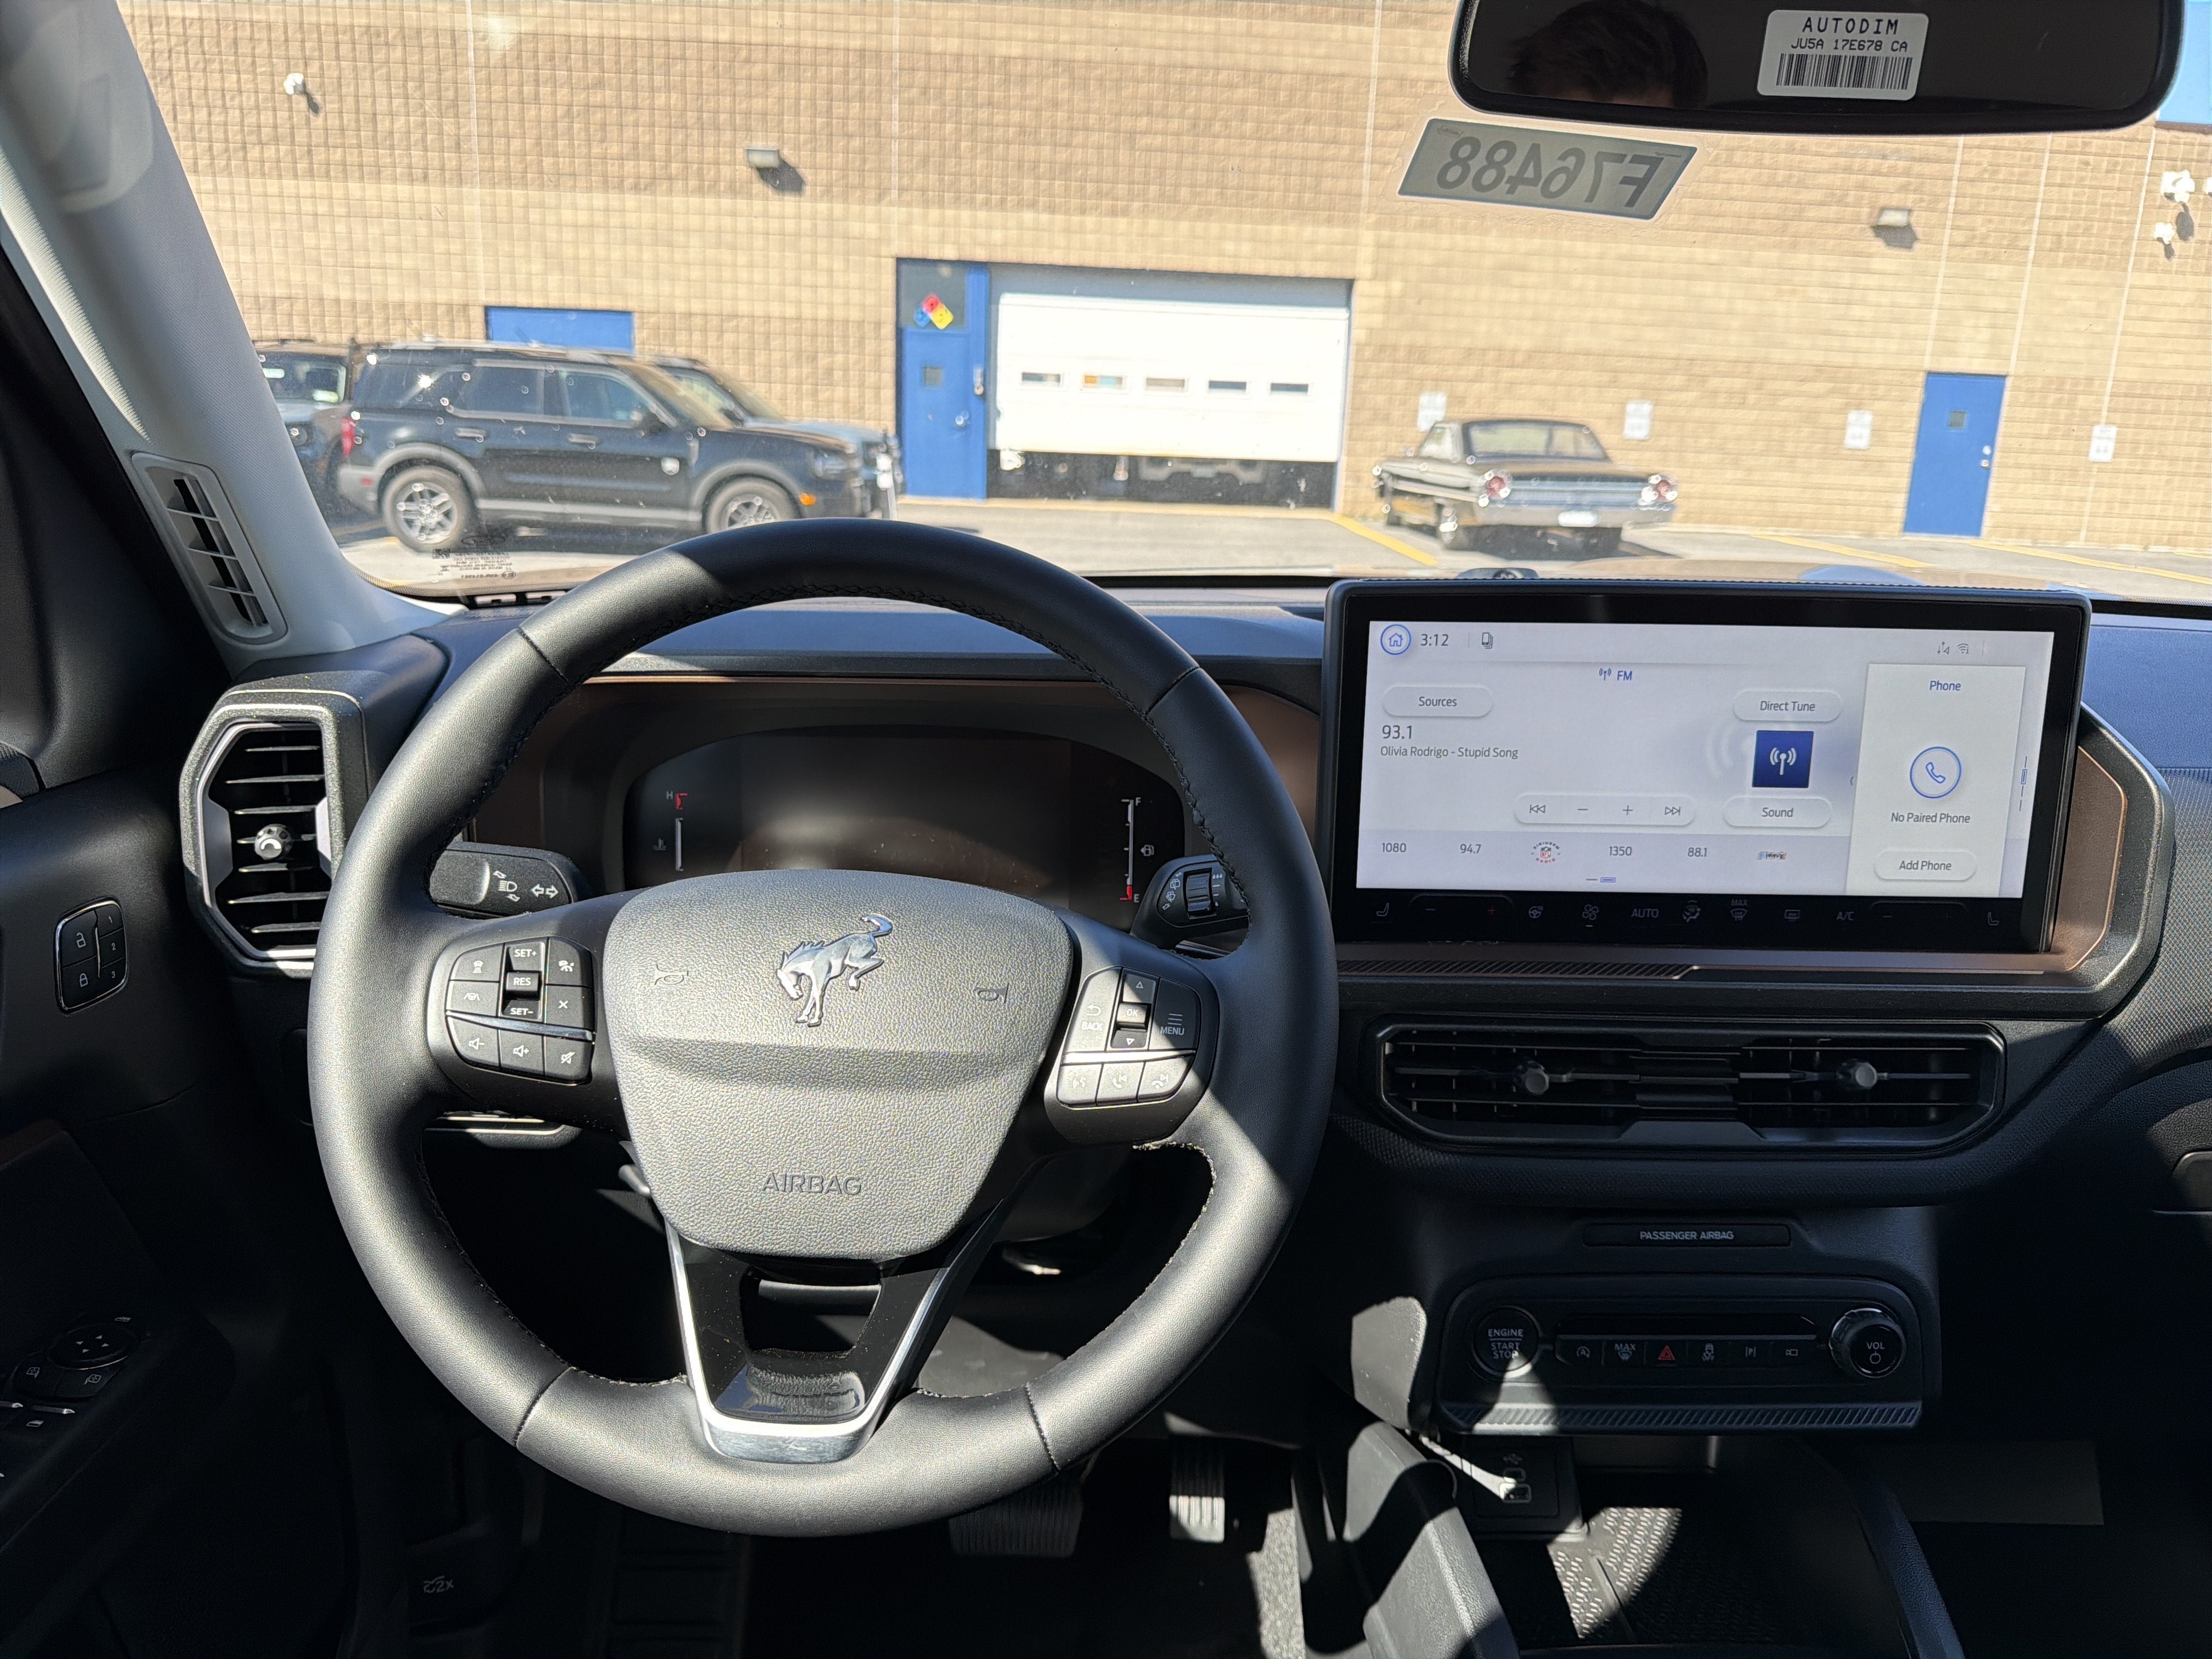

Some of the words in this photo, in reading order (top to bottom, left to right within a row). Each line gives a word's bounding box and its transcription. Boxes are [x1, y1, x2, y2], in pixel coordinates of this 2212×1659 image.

[1802, 17, 1899, 35] AUTODIM
[1791, 38, 1824, 49] JU5A
[1833, 39, 1882, 51] 17E678
[1891, 41, 1908, 52] CA
[1420, 634, 1449, 647] 3:12
[1617, 670, 1633, 681] FM
[1929, 680, 1961, 692] Phone
[1418, 696, 1457, 707] Sources
[1760, 701, 1788, 712] Direct
[1791, 701, 1815, 712] Tune
[1381, 725, 1413, 740] 93.1
[1380, 746, 1408, 757] Olivia
[1410, 746, 1448, 760] Rodrigo
[1457, 747, 1490, 760] Stupid
[1493, 747, 1518, 760] Song
[667, 791, 673, 800] H
[1136, 797, 1141, 806] F
[1762, 807, 1793, 818] Sound
[1891, 812, 1904, 823] No
[1906, 812, 1937, 823] Paired
[1939, 813, 1970, 824] Phone
[1381, 843, 1407, 853] 1080
[1460, 844, 1481, 854] 94.7
[1609, 846, 1632, 856] 1350
[1688, 847, 1707, 857] 88.1
[1899, 860, 1918, 871] Add
[1921, 861, 1951, 871] Phone
[1133, 894, 1139, 902] E
[1631, 909, 1659, 918] AUTO
[1836, 911, 1854, 921] A/C
[111, 943, 116, 951] 2
[111, 970, 116, 979] 3
[514, 978, 531, 986] RES
[1127, 1008, 1138, 1017] OK
[1081, 1022, 1103, 1031] BACK
[1160, 1026, 1184, 1035] MENU
[763, 1172, 861, 1195] AIRBAG
[1640, 1231, 1698, 1240] PASSENGER
[1700, 1231, 1734, 1240] AIRBAG
[1488, 1329, 1523, 1337] ENGINE
[1493, 1350, 1519, 1359] STOP
